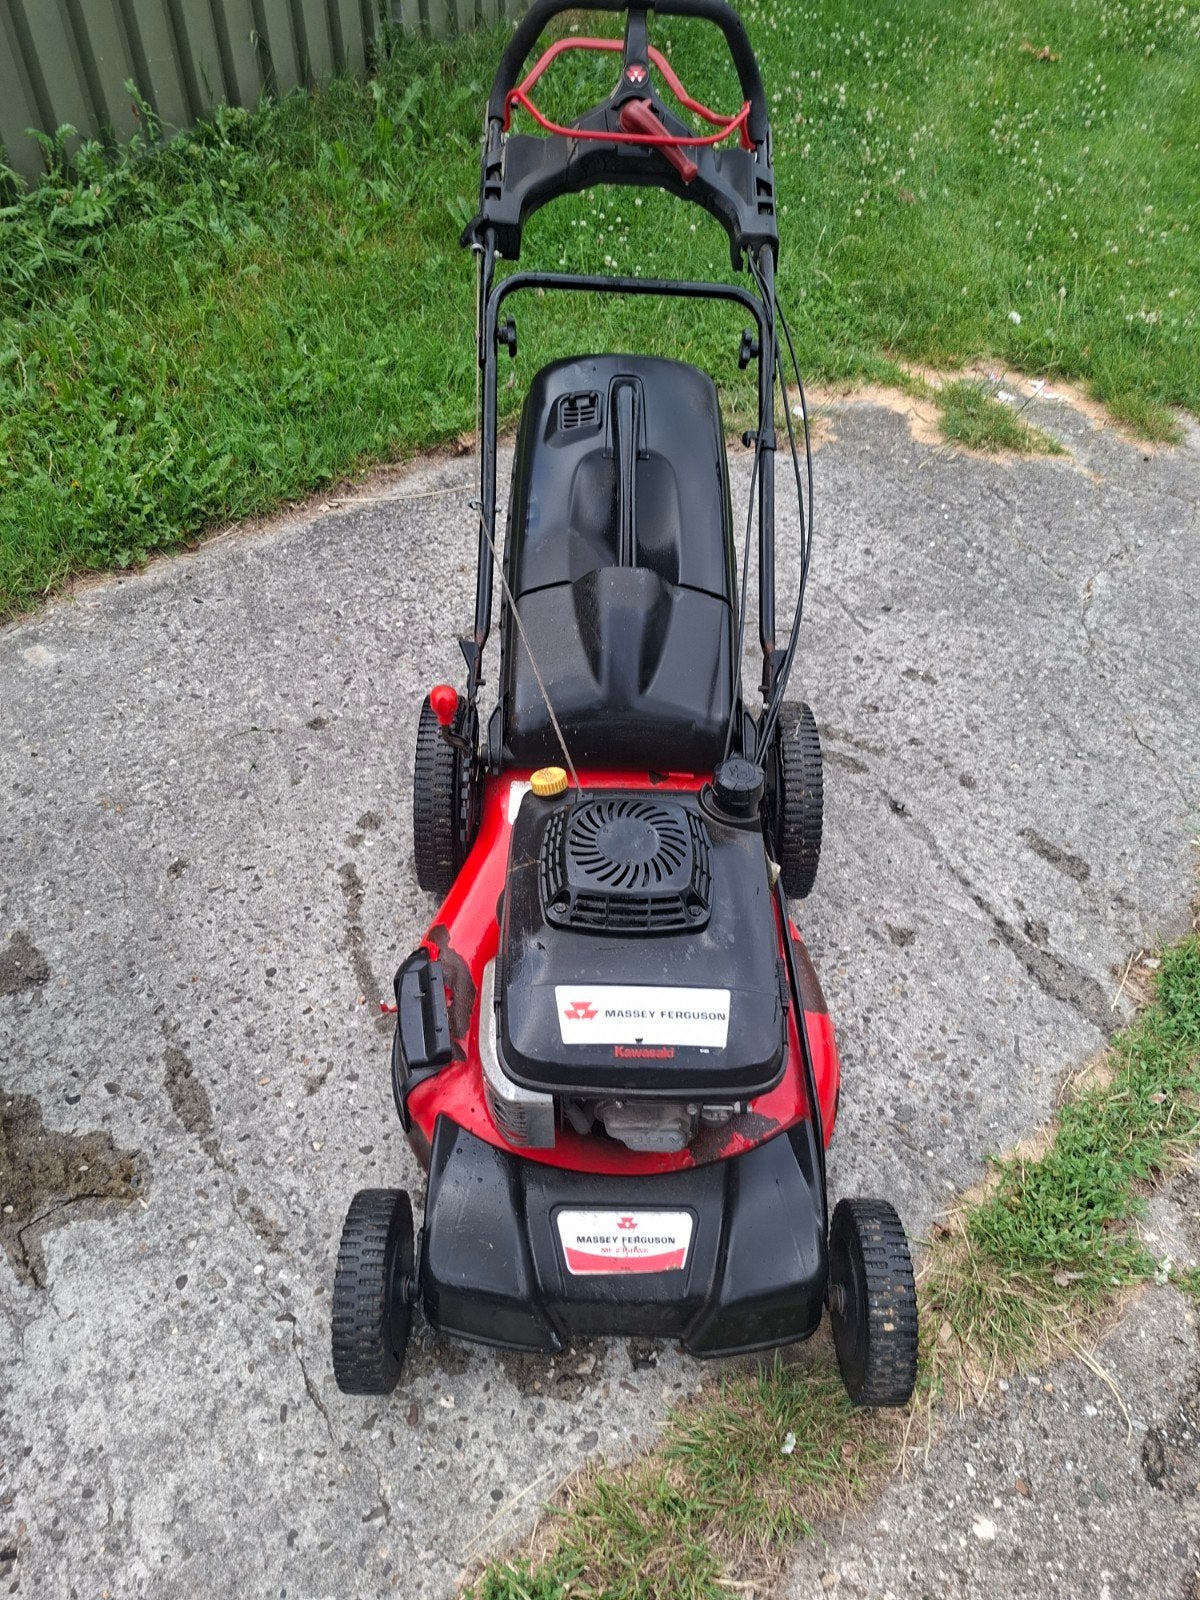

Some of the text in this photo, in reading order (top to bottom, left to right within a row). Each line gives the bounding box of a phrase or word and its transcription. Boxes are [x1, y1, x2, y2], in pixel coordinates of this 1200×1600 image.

[605, 1009, 726, 1021] MASSEY FERGUSON
[613, 1045, 675, 1060] Kawasaki
[576, 1235, 676, 1245] MASSEY FERGUSON
